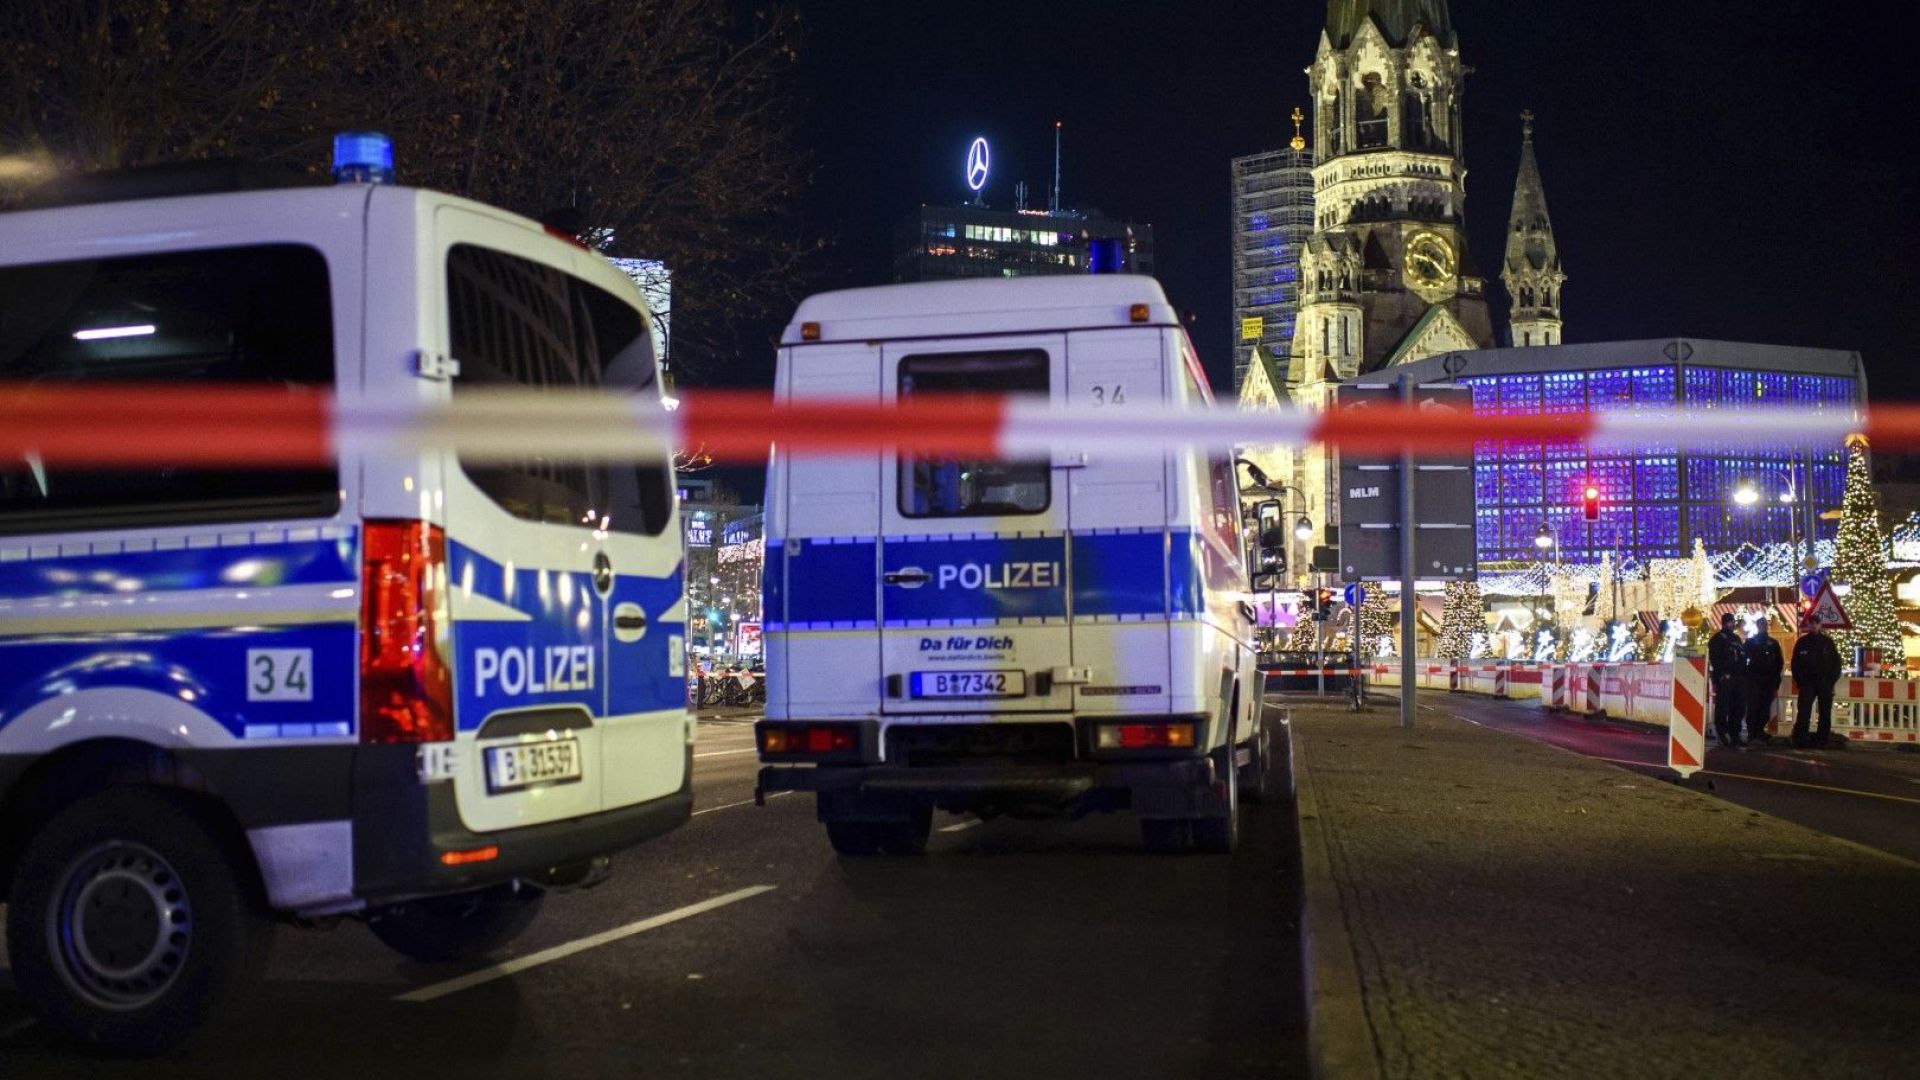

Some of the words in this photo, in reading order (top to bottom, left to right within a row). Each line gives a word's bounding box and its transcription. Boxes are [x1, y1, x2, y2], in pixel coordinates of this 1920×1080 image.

[1349, 486, 1380, 499] MLM
[939, 562, 1059, 589] POLIZEI
[919, 636, 942, 651] Da
[946, 635, 972, 651] für
[975, 634, 1014, 650] Dich
[254, 654, 307, 694] 34
[475, 645, 595, 698] POLIZEI
[936, 675, 948, 692] B
[961, 674, 1006, 693] 7342
[505, 751, 516, 780] B
[529, 744, 571, 778] 31539
